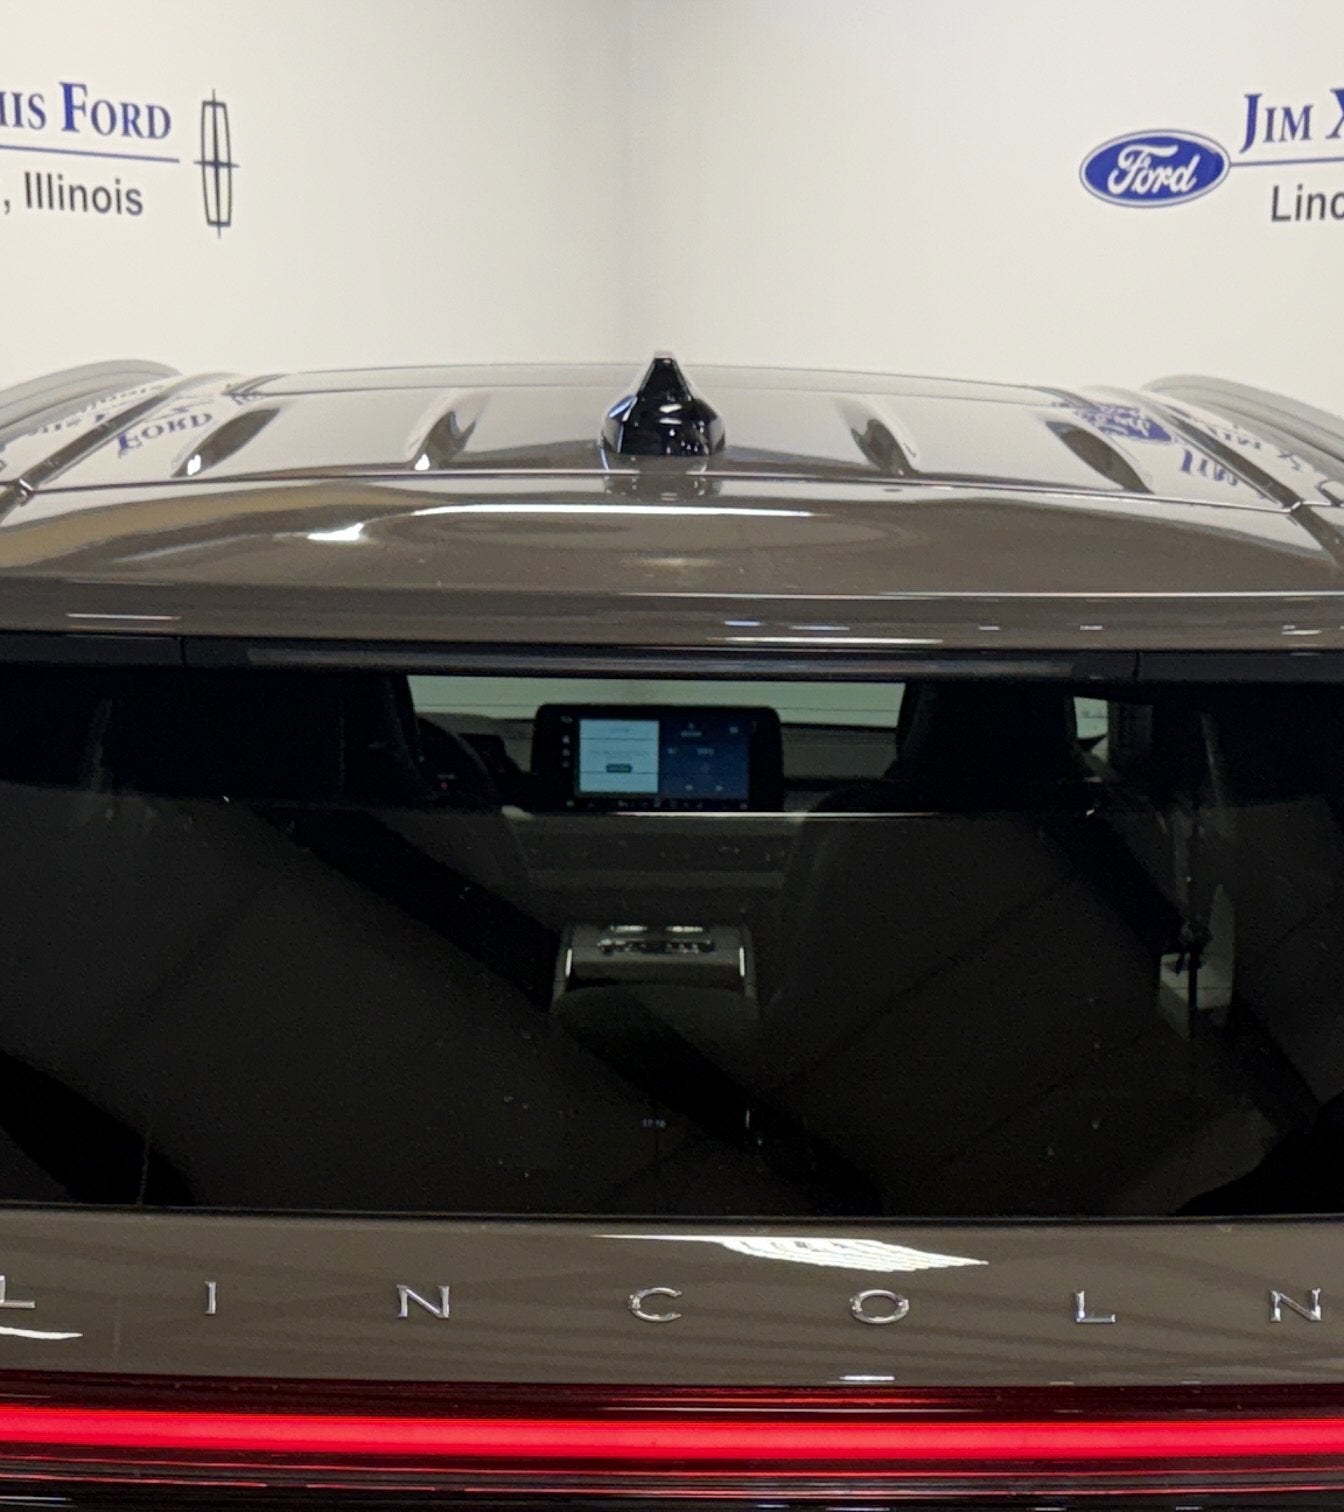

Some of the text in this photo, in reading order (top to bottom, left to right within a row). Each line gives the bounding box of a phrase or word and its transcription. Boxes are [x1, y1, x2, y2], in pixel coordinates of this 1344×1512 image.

[59, 82, 171, 140] FORD
[1238, 92, 1313, 154] JIM
[24, 171, 145, 216] Illinois
[1108, 144, 1197, 194] Ford
